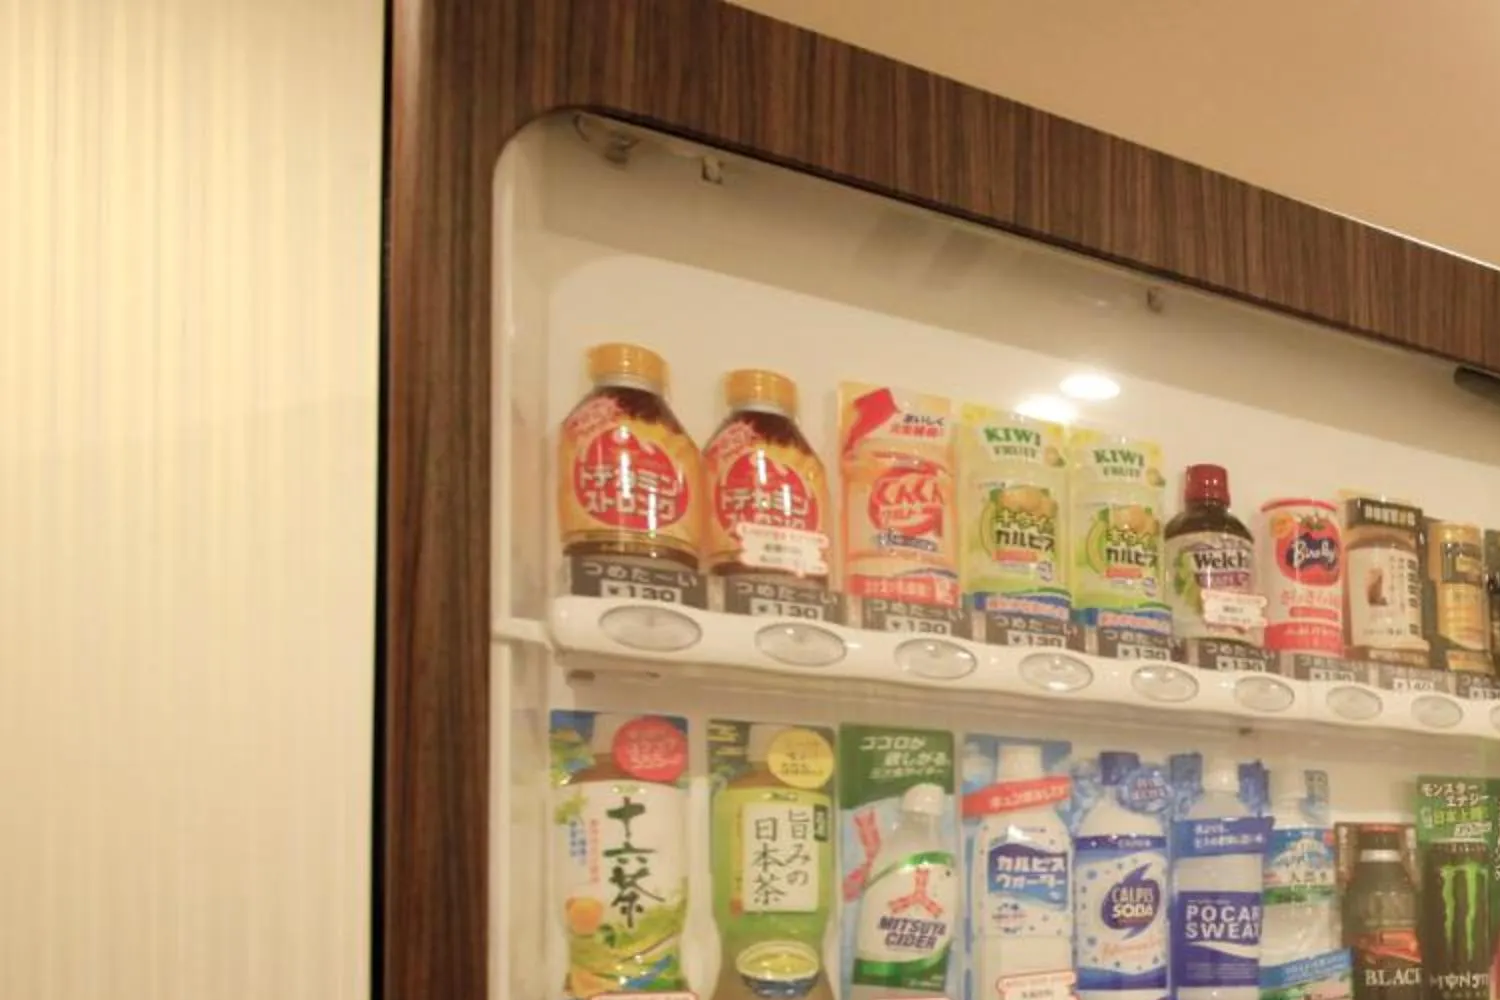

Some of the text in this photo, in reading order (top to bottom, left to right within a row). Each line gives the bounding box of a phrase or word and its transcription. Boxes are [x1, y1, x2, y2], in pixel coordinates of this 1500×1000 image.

[983, 425, 1042, 448] KIWI
[993, 443, 1038, 460] FRUIT
[1093, 448, 1145, 468] KIWI
[785, 808, 814, 887] 旨みの
[603, 797, 665, 929] 十六茶
[752, 817, 787, 906] 日本茶
[996, 854, 1066, 875] カルピス
[996, 873, 1065, 891] ウォーター
[1111, 903, 1154, 919] SODA
[877, 916, 947, 937] MITSUYA
[884, 932, 938, 951] CIDER
